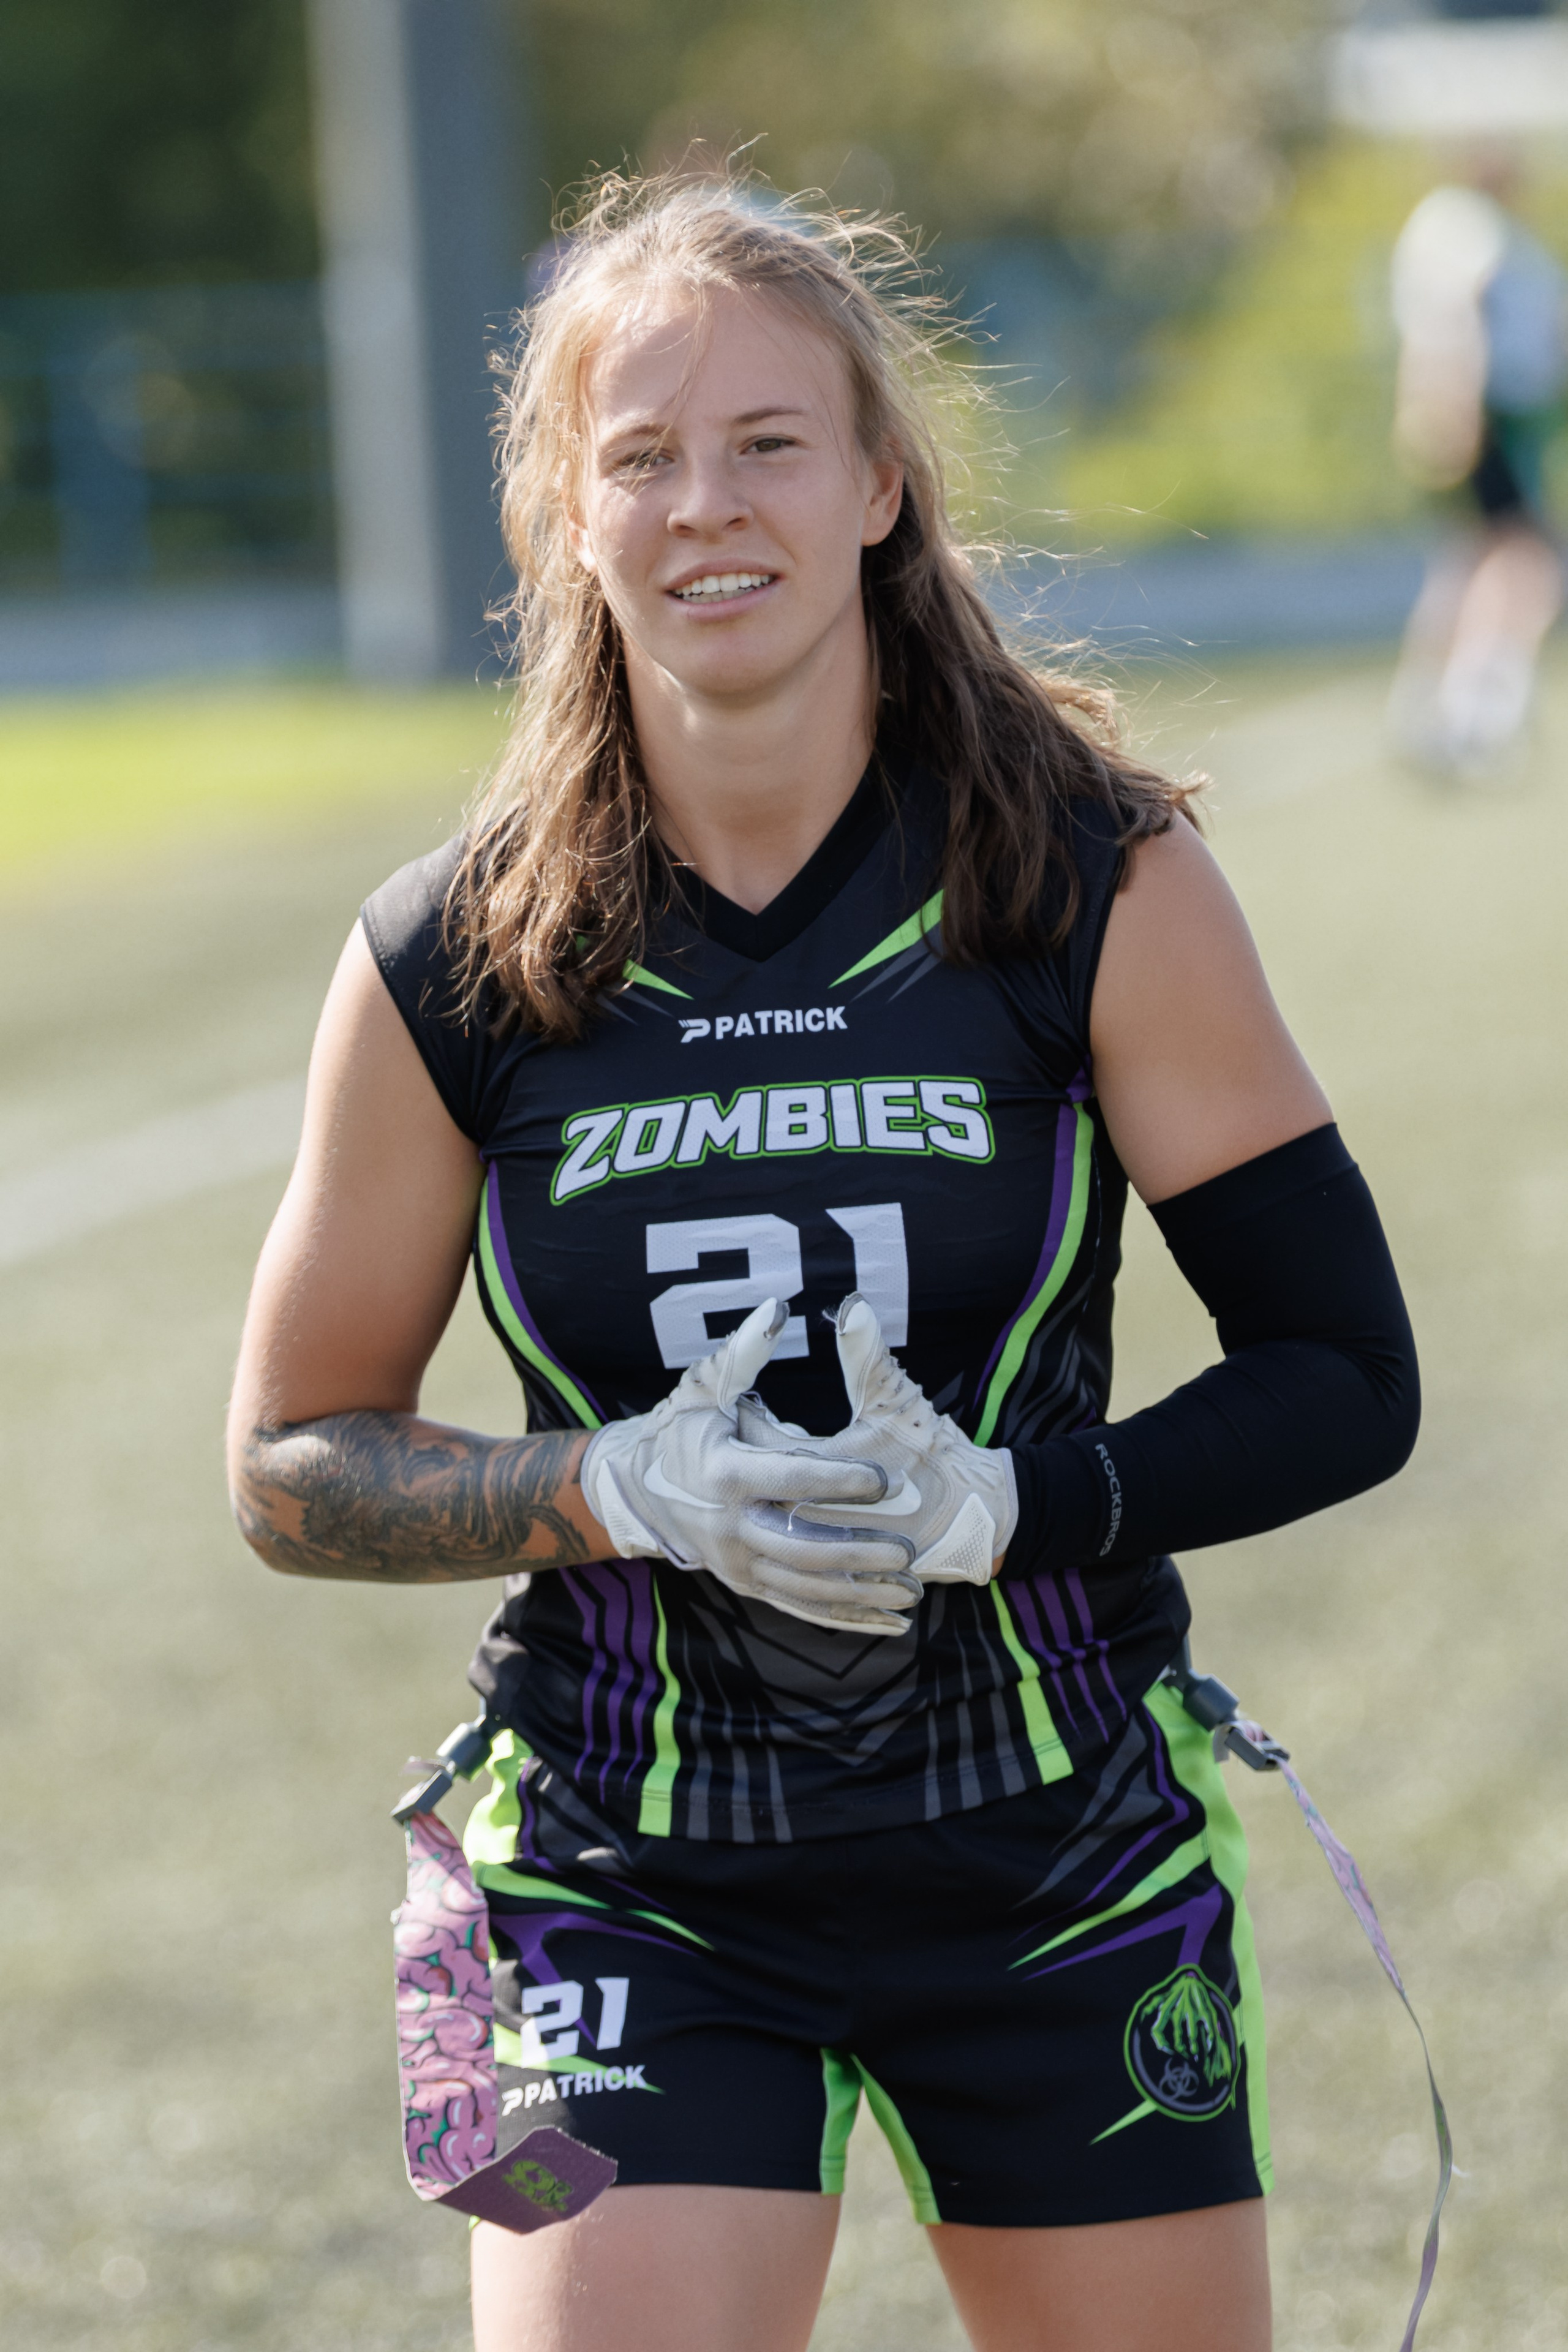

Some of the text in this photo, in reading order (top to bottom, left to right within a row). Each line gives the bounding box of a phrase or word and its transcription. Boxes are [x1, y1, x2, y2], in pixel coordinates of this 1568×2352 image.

[715, 1006, 848, 1039] PATRICK
[550, 1076, 996, 1205] ZOMBIES
[646, 1202, 909, 1370] 21
[1095, 1443, 1122, 1556] ROCKBROS
[519, 1977, 630, 2068] 21
[524, 2065, 647, 2109] PATRICK
